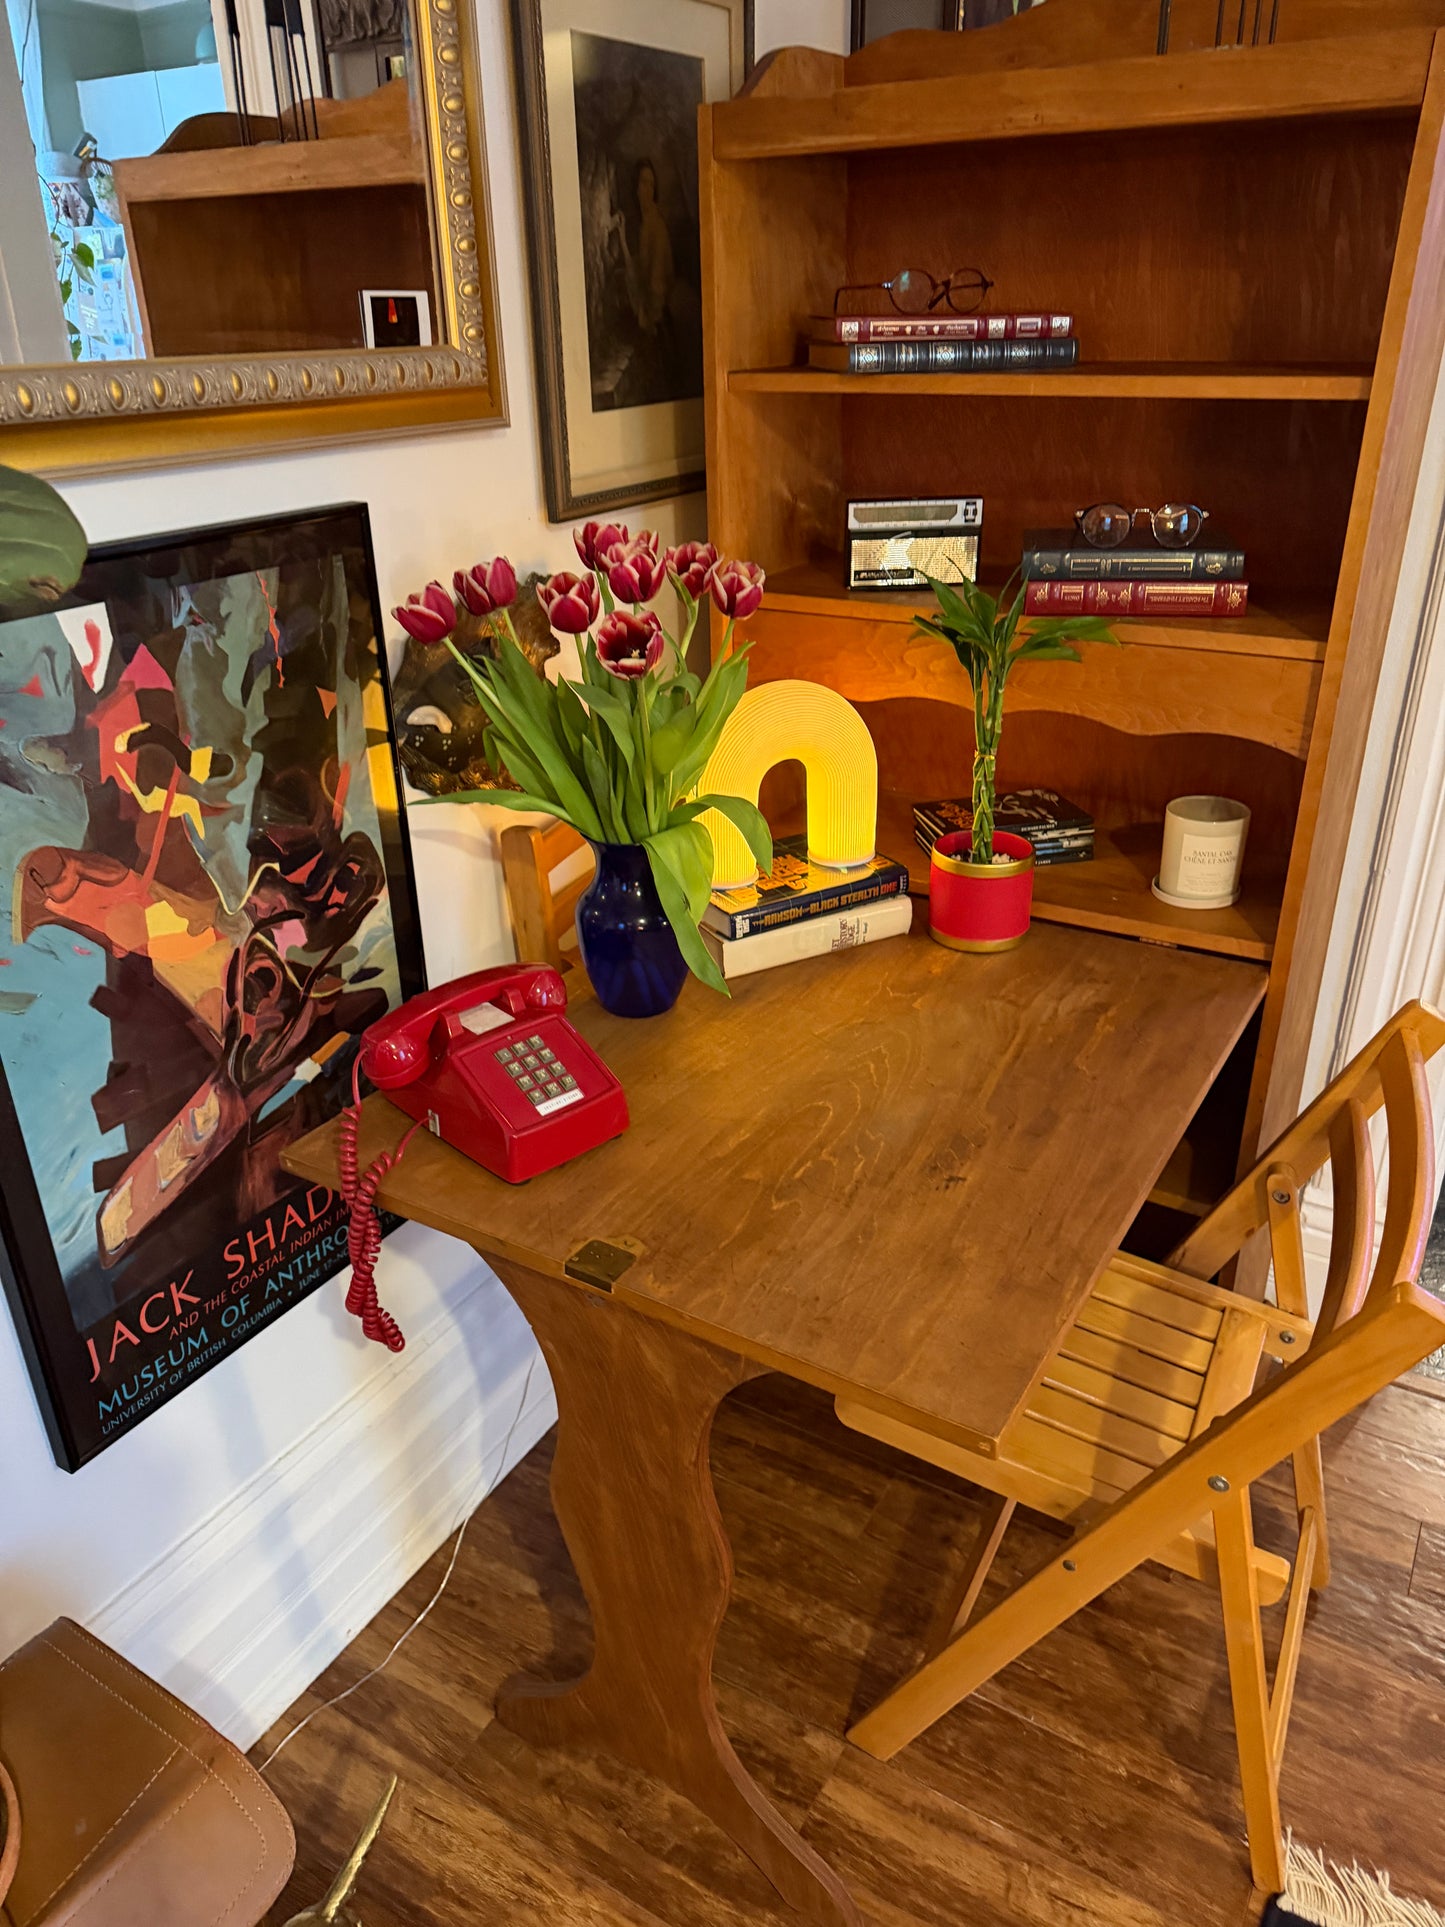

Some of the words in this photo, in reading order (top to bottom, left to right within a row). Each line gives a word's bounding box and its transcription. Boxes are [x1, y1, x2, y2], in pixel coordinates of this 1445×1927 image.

[764, 906, 803, 927] RANSOM
[809, 896, 839, 915] BLACK
[840, 886, 880, 907] STEALTH
[879, 881, 898, 896] ONE
[86, 1269, 201, 1384] JACK
[223, 1184, 334, 1280] SHAD
[97, 1326, 209, 1421] MUSEUM
[220, 1293, 251, 1328] OF
[264, 1224, 350, 1300] ANTHRO
[102, 1381, 167, 1436] UNIVERSITY
[169, 1370, 185, 1386] OF
[187, 1337, 227, 1373] BRITISH
[231, 1296, 283, 1339] COLUMBIA
[298, 1268, 321, 1291] JUNE
[169, 1311, 200, 1341] AND
[203, 1290, 228, 1315] THE
[231, 1250, 286, 1295] COASTAL
[290, 1218, 333, 1253] INDIAN
